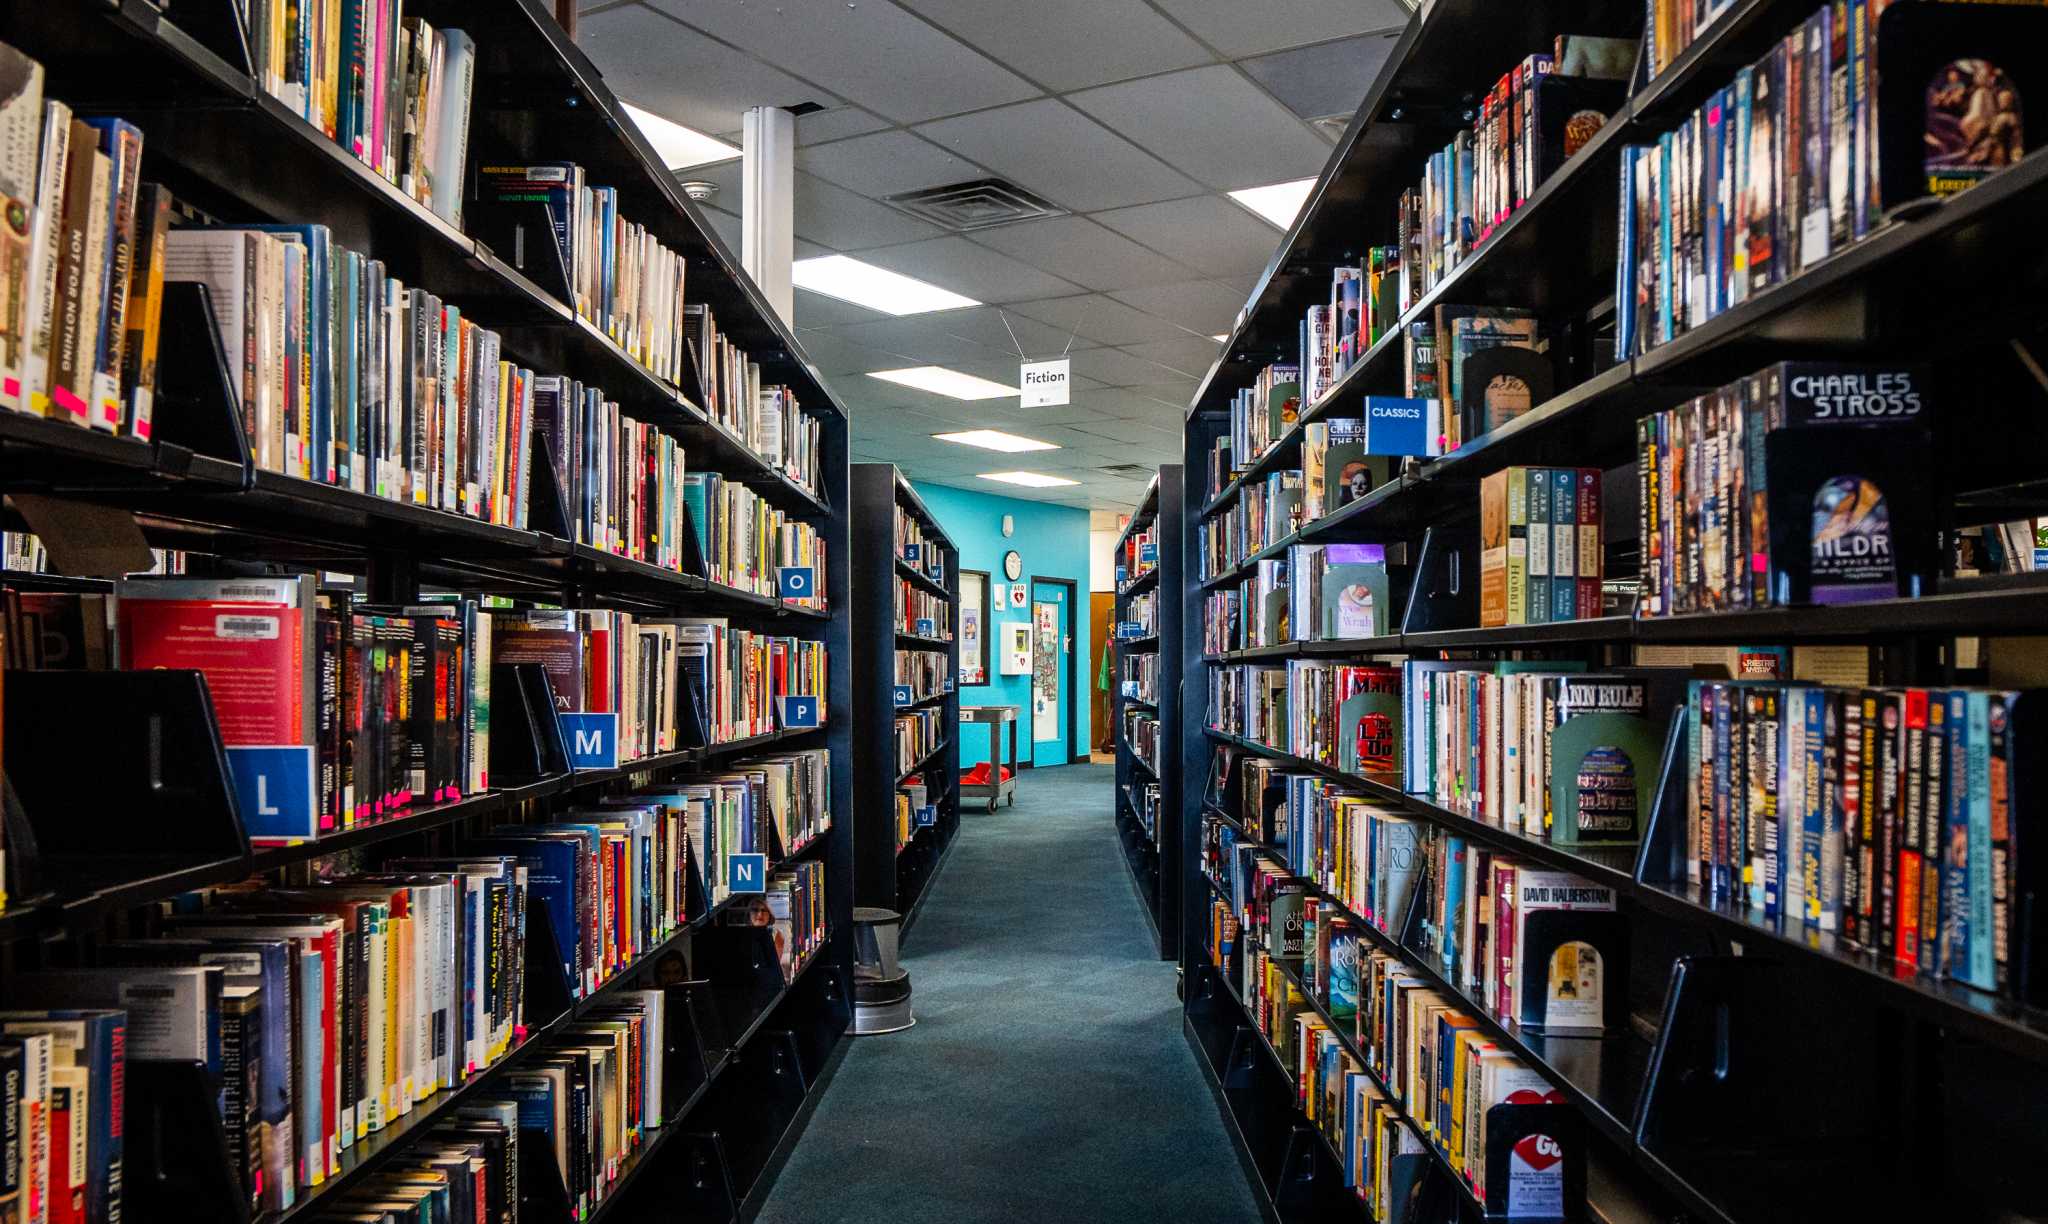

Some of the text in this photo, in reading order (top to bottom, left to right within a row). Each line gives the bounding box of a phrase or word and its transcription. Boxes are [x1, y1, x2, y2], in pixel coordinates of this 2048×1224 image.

[61, 229, 83, 372] NOT FOR NOTHING
[1025, 371, 1065, 386] Fiction
[1273, 371, 1297, 385] DICK
[1790, 373, 1911, 398] CHARLES
[1372, 407, 1420, 419] CLASSICS
[1814, 393, 1921, 418] STROSS
[1556, 487, 1564, 522] TOLKIEN
[1580, 487, 1588, 523] TOLKIEN
[908, 549, 915, 558] S
[1689, 543, 1699, 584] FLASH
[789, 574, 805, 590] O
[932, 569, 940, 577] W
[1510, 564, 1521, 614] HOBBIT
[896, 691, 907, 702] Q
[1558, 685, 1643, 707] ANN RULE
[797, 705, 808, 719] P
[575, 730, 602, 755] M
[1844, 704, 1862, 802] REDLAW
[258, 775, 279, 815] L
[1765, 820, 1778, 849] ALLEN
[737, 863, 752, 881] N
[1765, 853, 1778, 884] STEELE
[1991, 847, 2007, 900] DAVID
[1523, 887, 1611, 903] DAVID HALBERSTAM
[1993, 902, 2008, 963] WEBER
[38, 1038, 48, 1103] GARRISON
[5, 1068, 20, 1187] Garrison Keillor
[76, 1089, 84, 1138] Garrison
[107, 1158, 123, 1196] THE
